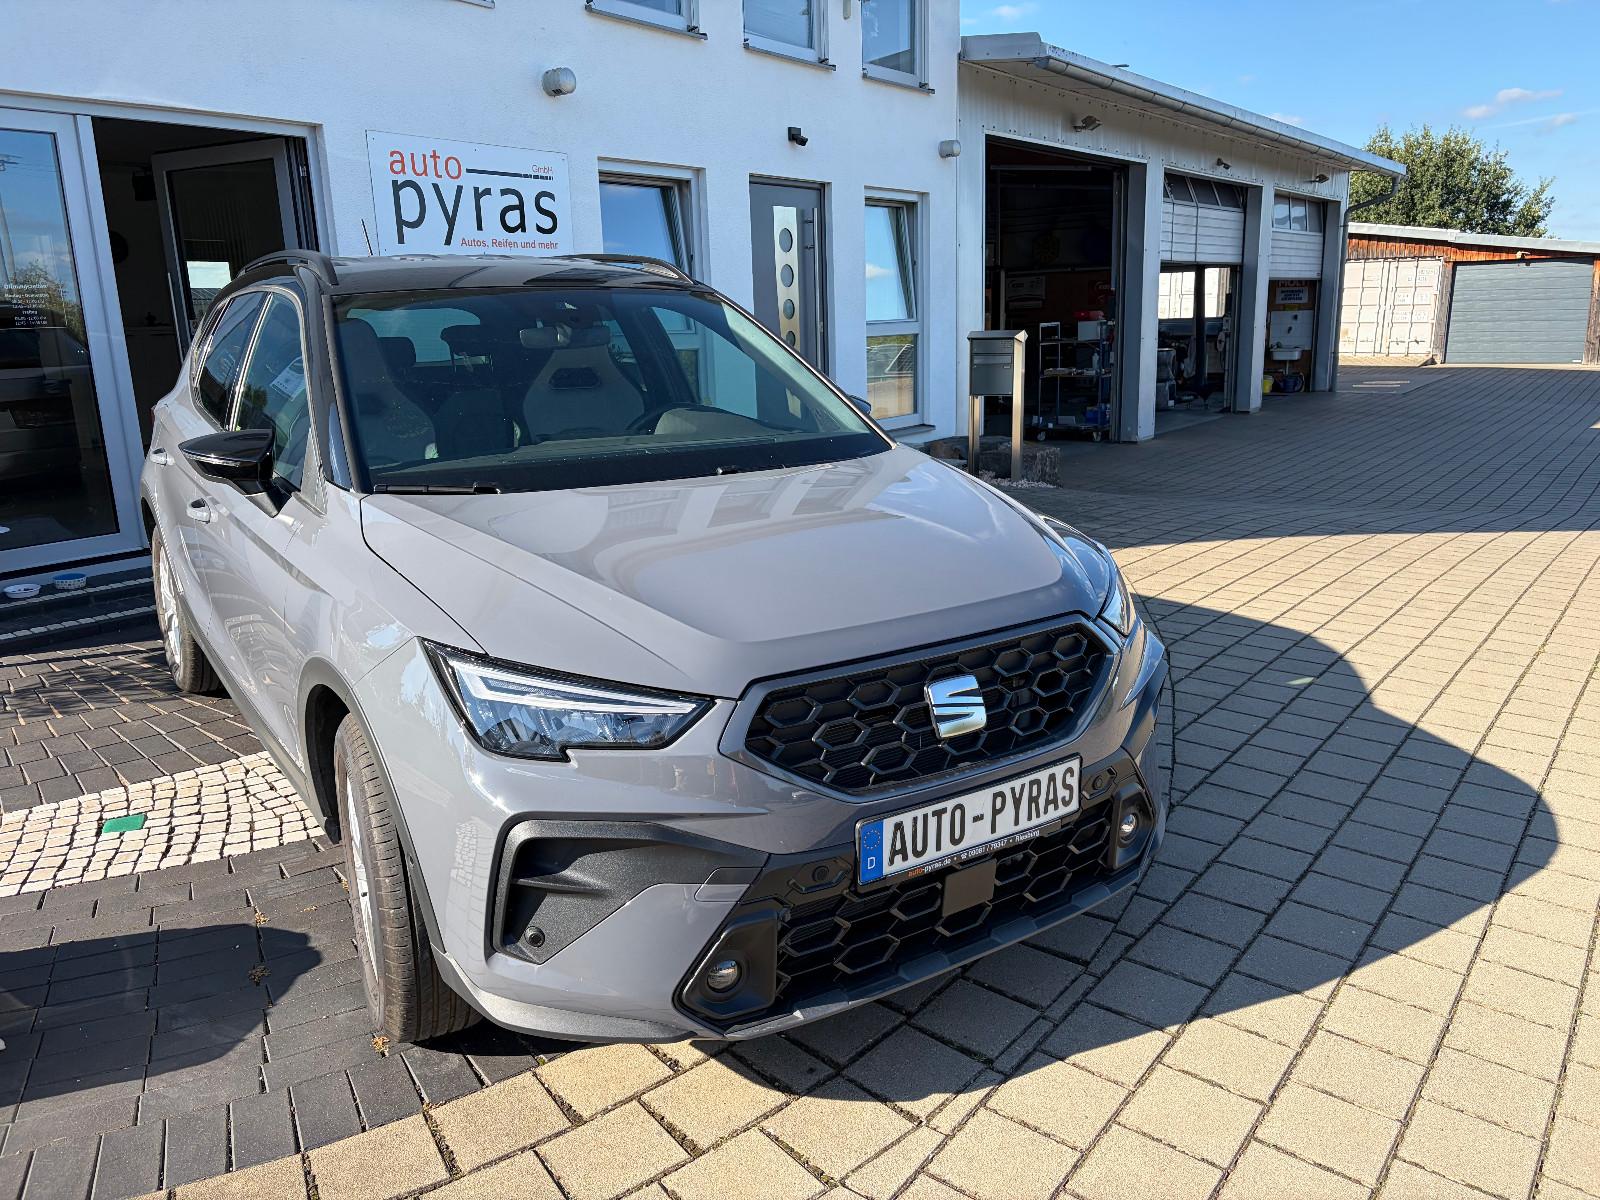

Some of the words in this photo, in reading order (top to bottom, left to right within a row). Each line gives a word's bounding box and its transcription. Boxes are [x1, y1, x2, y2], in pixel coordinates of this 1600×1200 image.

[389, 149, 462, 180] auto
[532, 164, 554, 174] GmbH
[391, 179, 558, 246] pyras
[460, 238, 489, 248] Autos,
[491, 239, 519, 249] Reifen
[520, 240, 536, 249] und
[538, 241, 559, 250] mehr
[867, 856, 876, 870] D
